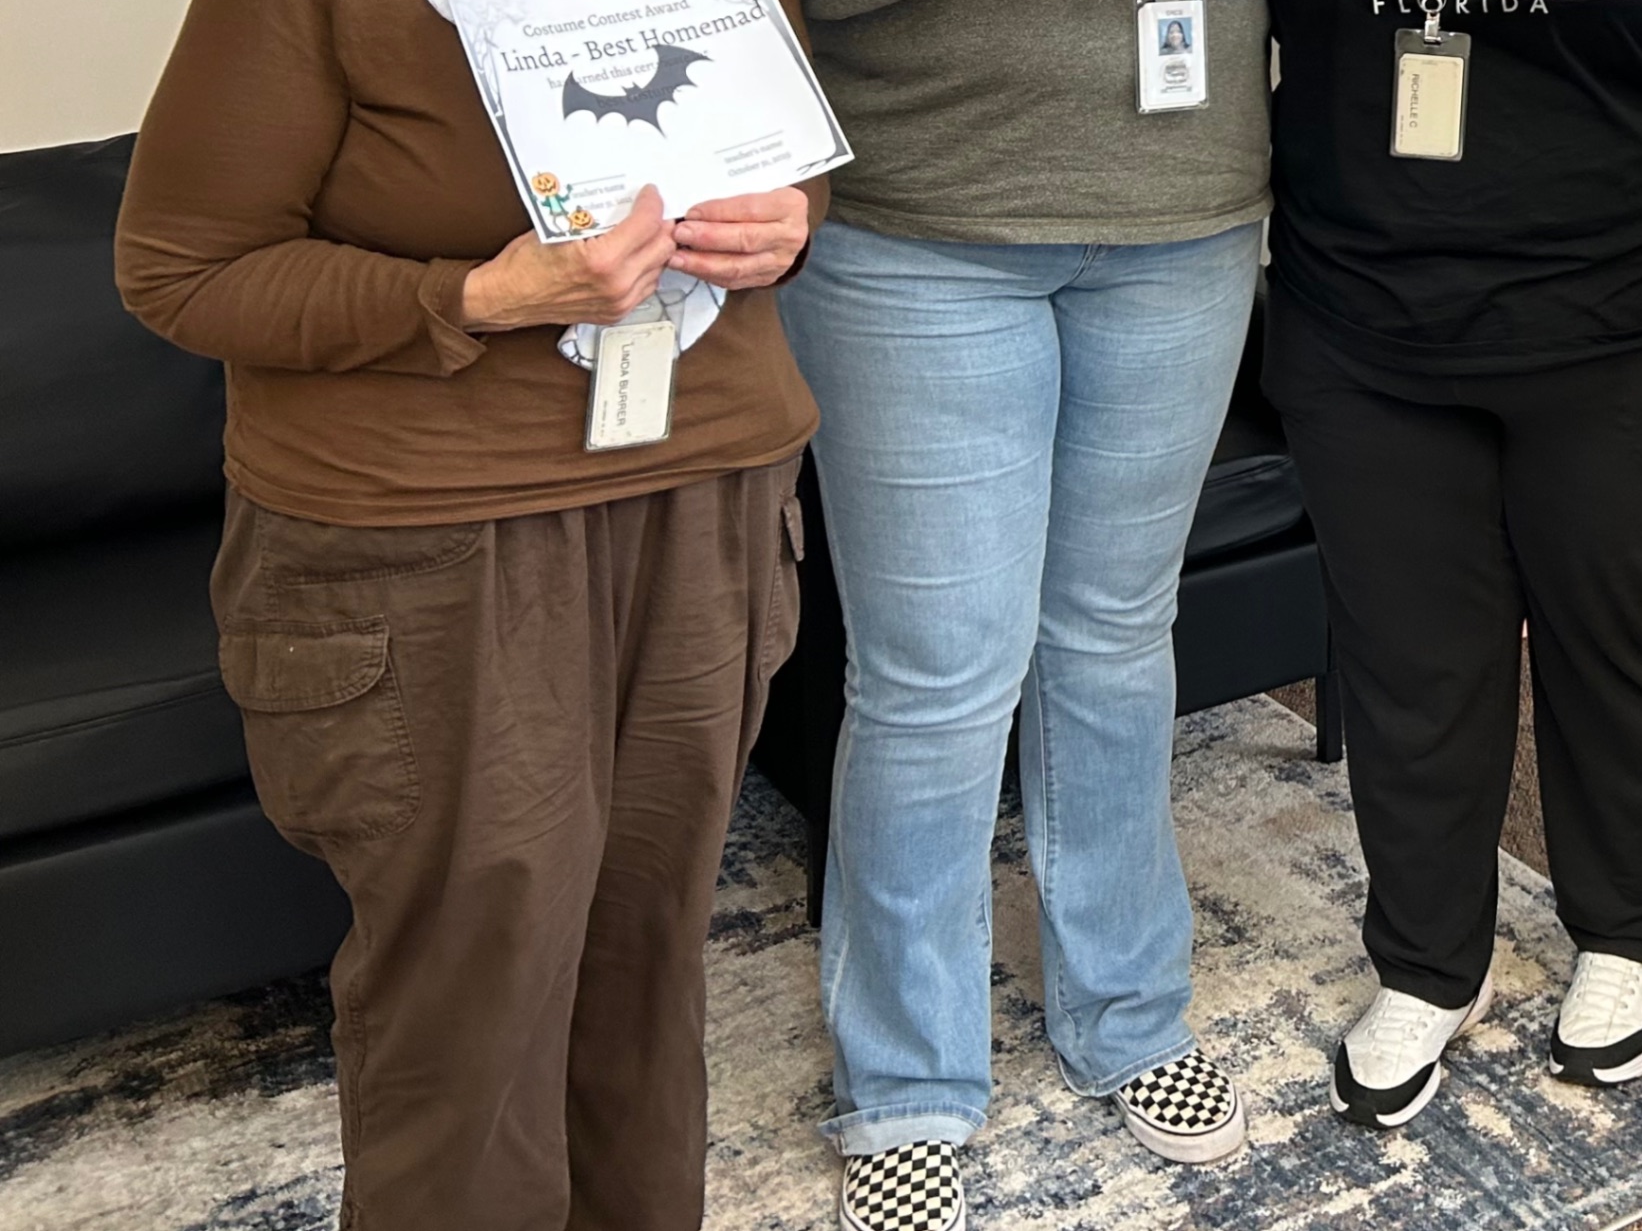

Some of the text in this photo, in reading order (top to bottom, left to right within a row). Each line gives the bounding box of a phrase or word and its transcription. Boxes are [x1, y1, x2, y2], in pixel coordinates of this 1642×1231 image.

[523, 18, 586, 38] Costume
[588, 7, 642, 28] Contest
[501, 46, 567, 72] Linda
[584, 36, 637, 62] Best
[575, 70, 608, 86] arned
[610, 66, 632, 81] this
[1410, 73, 1420, 119] RICHELLE
[616, 343, 633, 426] LINDA BURRER
